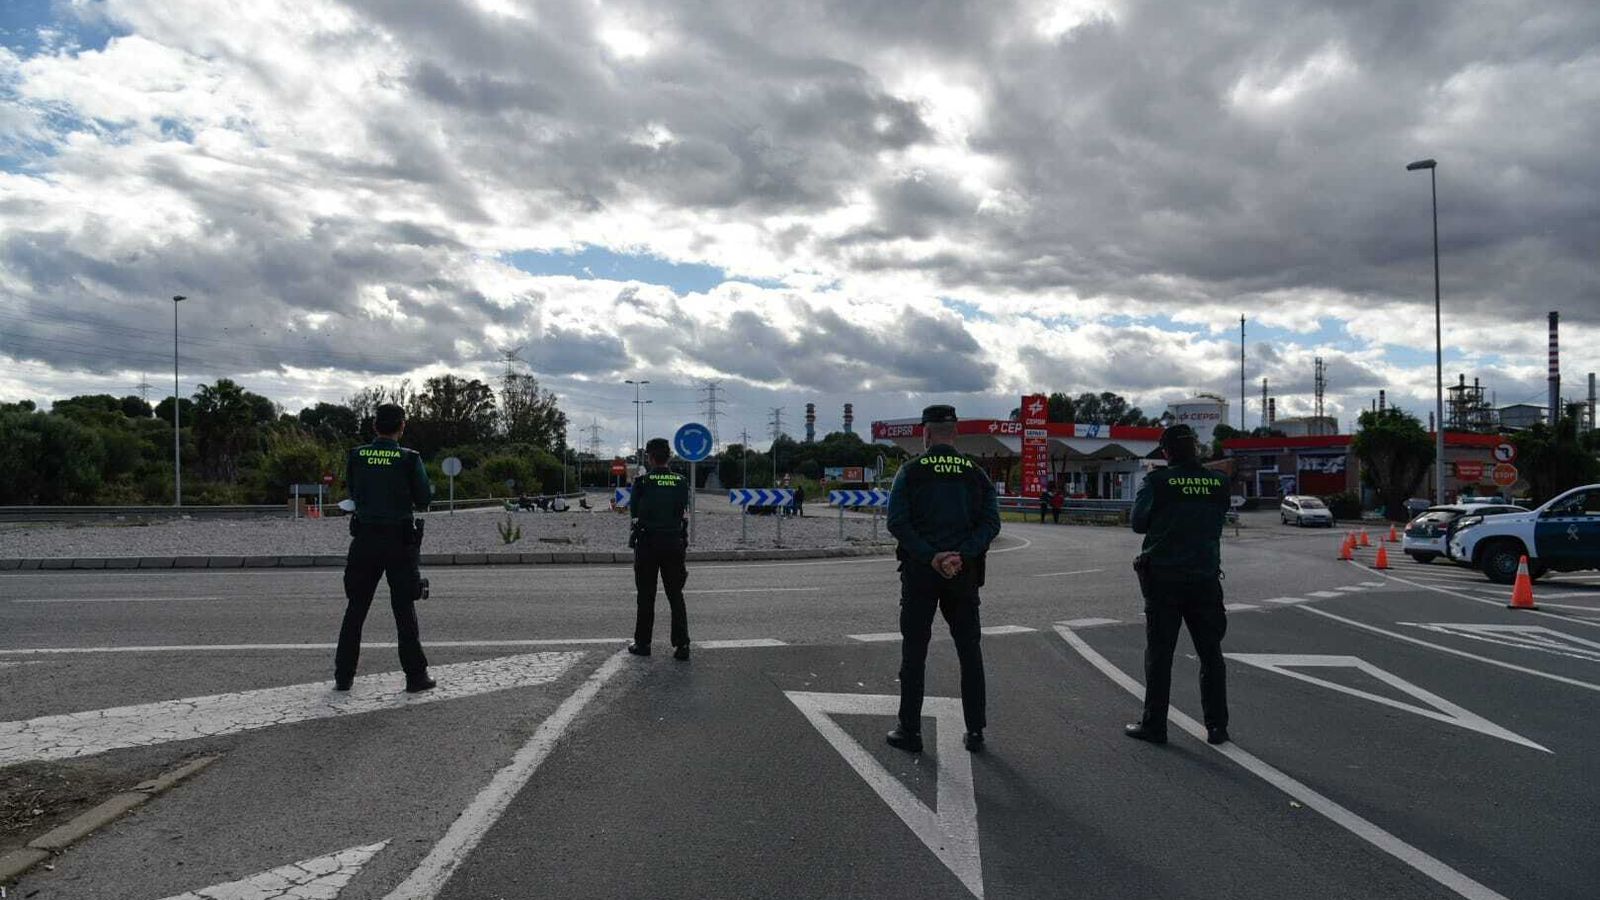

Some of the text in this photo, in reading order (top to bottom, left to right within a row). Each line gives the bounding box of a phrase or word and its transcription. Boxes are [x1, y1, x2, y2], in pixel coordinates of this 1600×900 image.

[887, 424, 913, 437] CEPSA
[1000, 422, 1023, 434] CEP
[359, 449, 401, 458] GUARDIA
[367, 457, 392, 465] CIVIL
[920, 456, 973, 468] GUARDIA
[934, 464, 962, 473] CIVIL
[1168, 477, 1221, 486] GUARDIA
[1182, 486, 1211, 495] CIVIL
